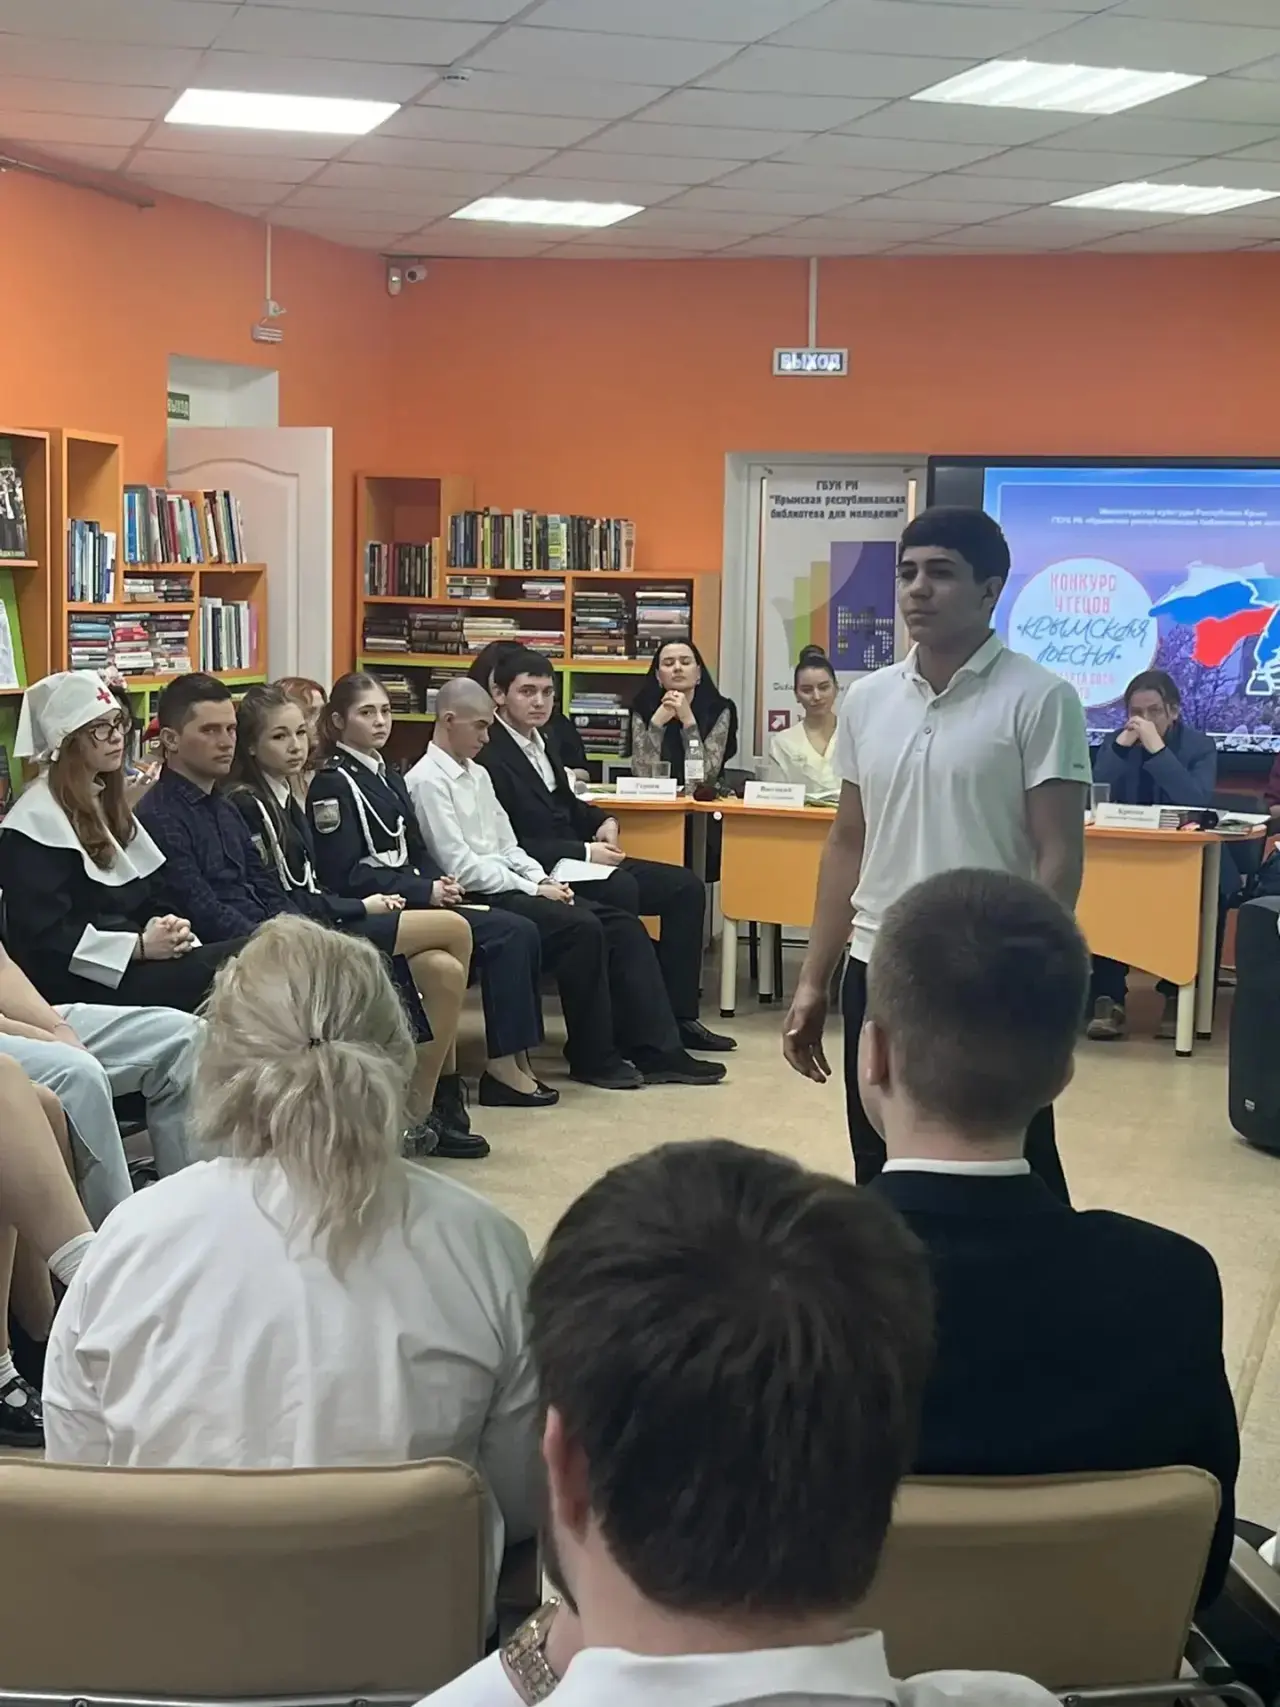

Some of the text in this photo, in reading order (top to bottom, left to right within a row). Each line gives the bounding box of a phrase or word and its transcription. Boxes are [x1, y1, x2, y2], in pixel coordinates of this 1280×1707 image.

[779, 352, 841, 372] ВЫХОД
[770, 508, 825, 519] библиотека
[827, 509, 846, 520] для
[1051, 572, 1117, 592] КОНКУРС
[1055, 596, 1111, 615] ЧТЕЦОВ
